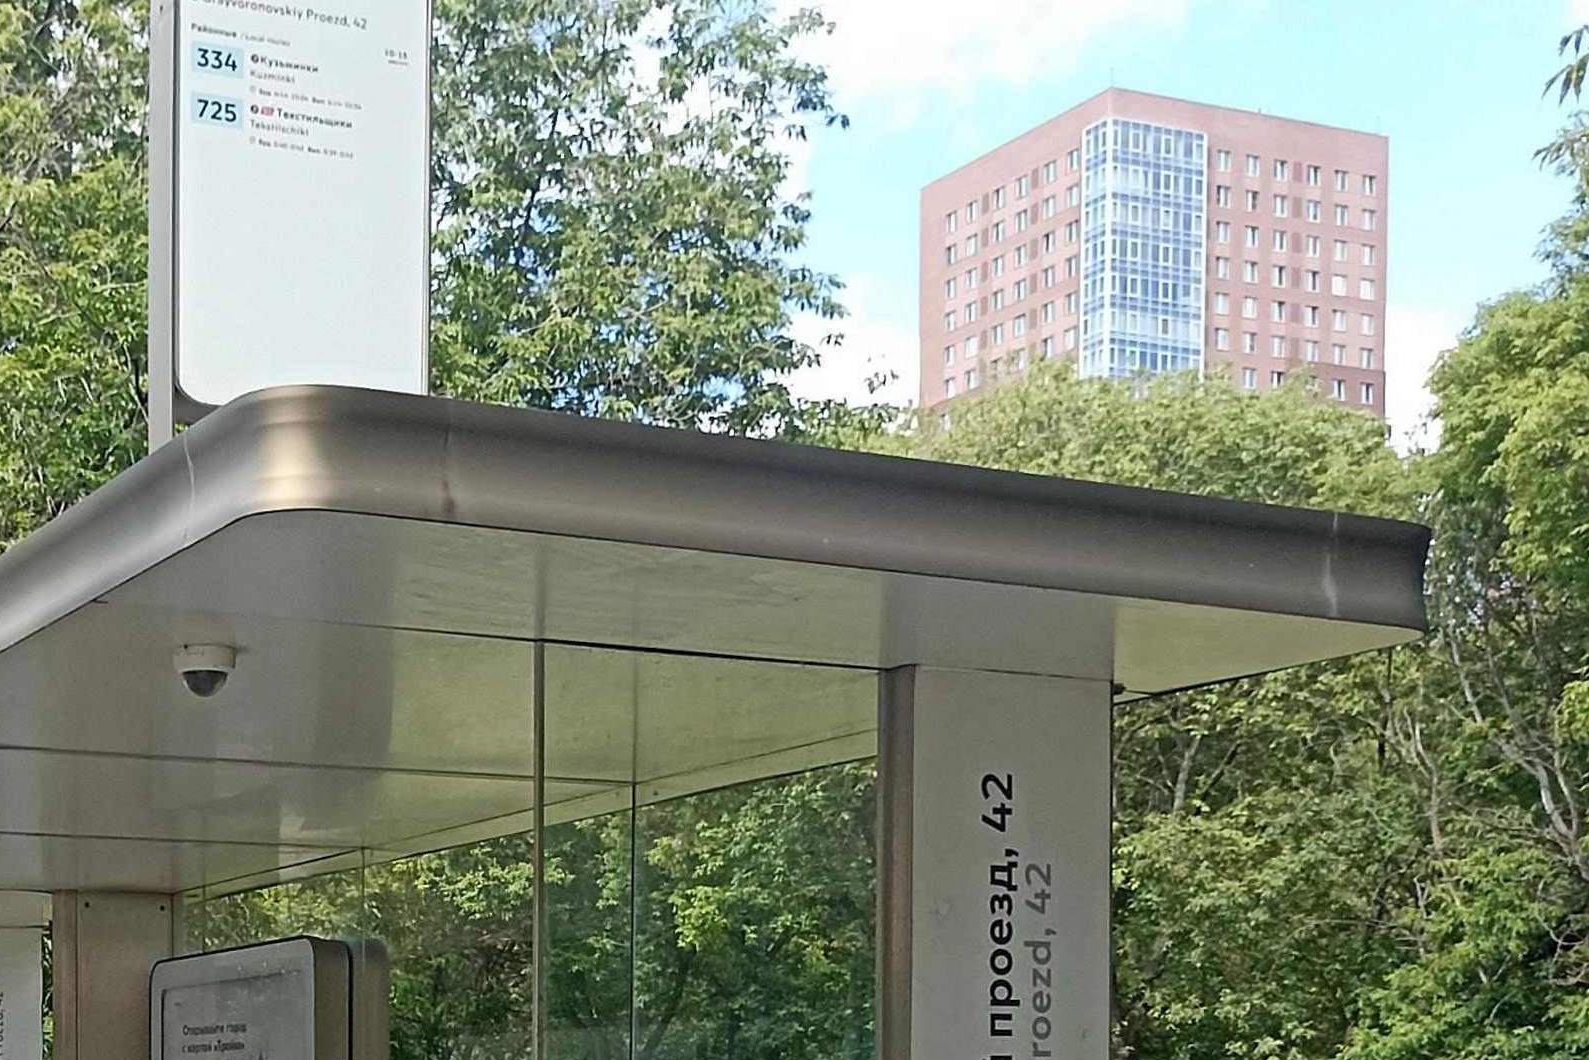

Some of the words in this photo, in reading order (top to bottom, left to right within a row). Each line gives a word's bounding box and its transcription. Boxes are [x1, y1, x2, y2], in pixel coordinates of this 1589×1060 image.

[353, 18, 368, 30] 42
[196, 48, 237, 72] 334
[196, 99, 237, 122] 725
[981, 773, 1013, 833] 42
[1024, 863, 1052, 915] 42
[989, 848, 1020, 1037] проезд,
